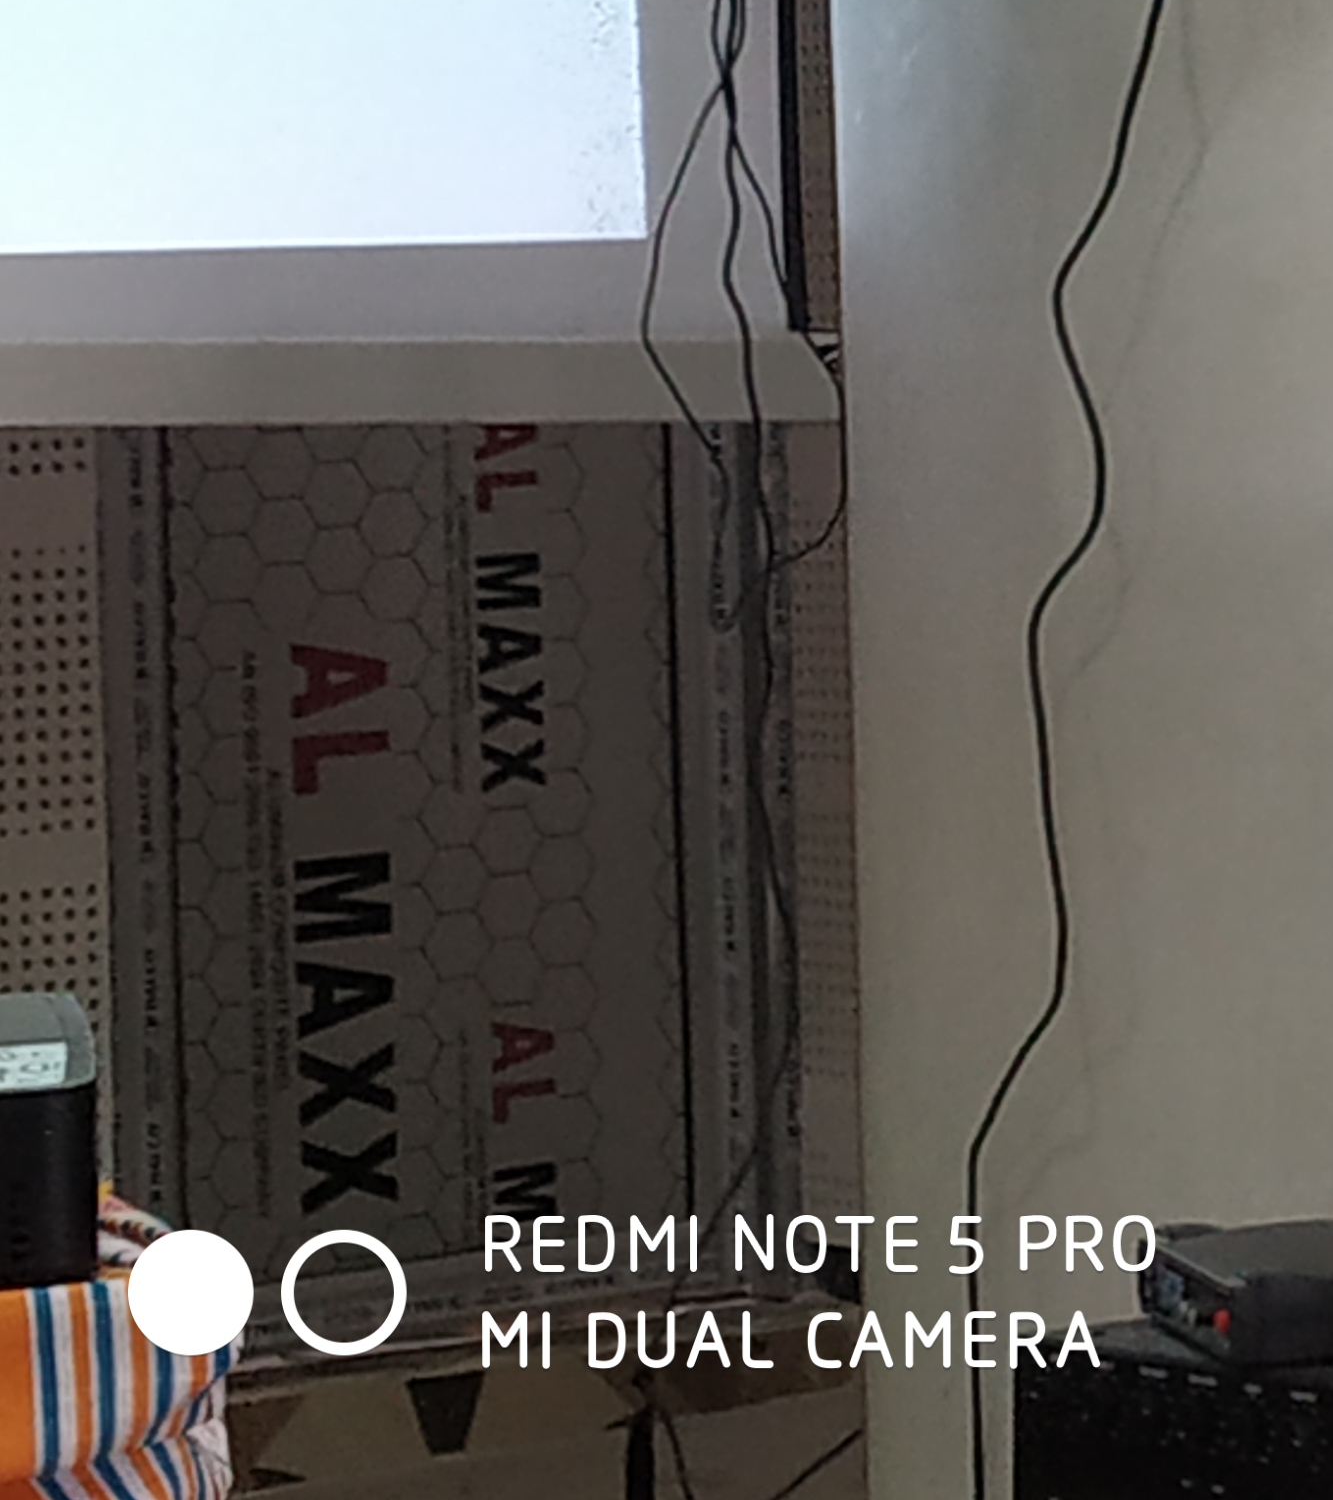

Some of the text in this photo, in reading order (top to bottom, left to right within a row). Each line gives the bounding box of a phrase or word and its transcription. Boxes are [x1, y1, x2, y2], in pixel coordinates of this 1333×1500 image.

[475, 423, 547, 792] AL MAXX
[290, 643, 398, 1214] AL MAXX
[492, 1022, 556, 1124] AL
